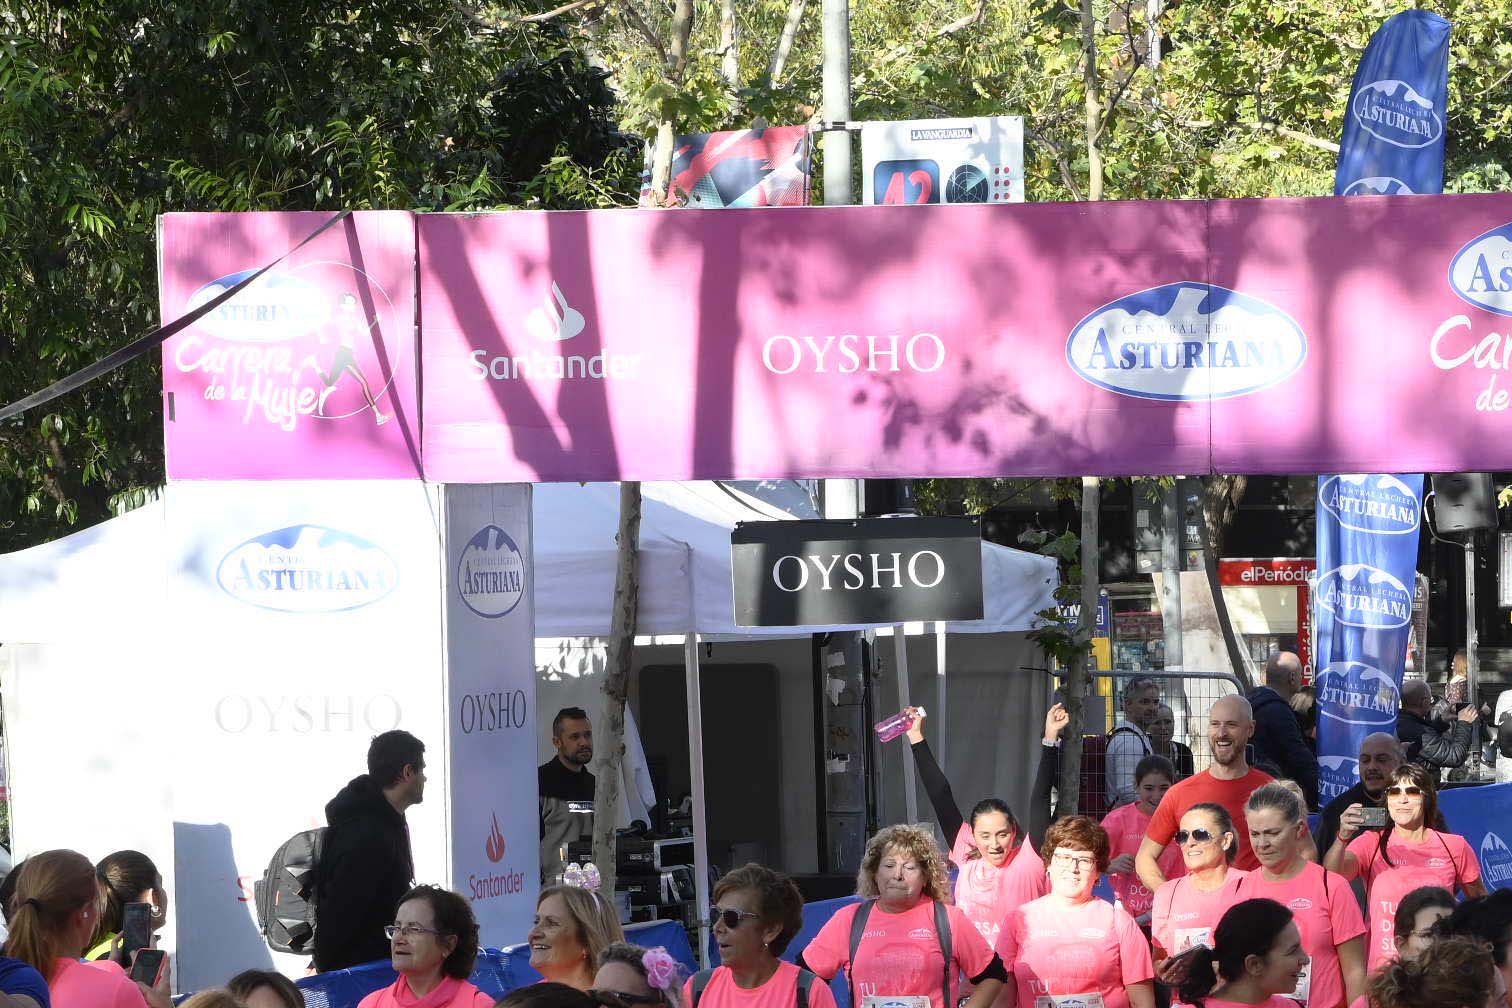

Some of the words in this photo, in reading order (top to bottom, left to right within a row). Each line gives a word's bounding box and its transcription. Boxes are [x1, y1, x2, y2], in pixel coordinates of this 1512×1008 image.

[921, 128, 971, 140] VANGUARDIA
[175, 336, 293, 373] Carrera
[469, 348, 643, 380] Santander
[761, 332, 946, 375] OYSHO
[1086, 327, 1289, 370] ASTURIANA
[204, 374, 226, 401] de
[242, 366, 338, 432] Mujer
[1475, 373, 1511, 413] de
[1328, 483, 1416, 526] ASTURIANA
[233, 556, 387, 592] ASTURIANA
[463, 565, 522, 596] ASTURIANA
[772, 549, 946, 593] OYSHO
[1325, 579, 1408, 620] ASTURIANA
[215, 693, 403, 735] OYSHO
[460, 688, 527, 735] OYSHO
[469, 867, 526, 902] Santander
[1027, 980, 1049, 994] TU
